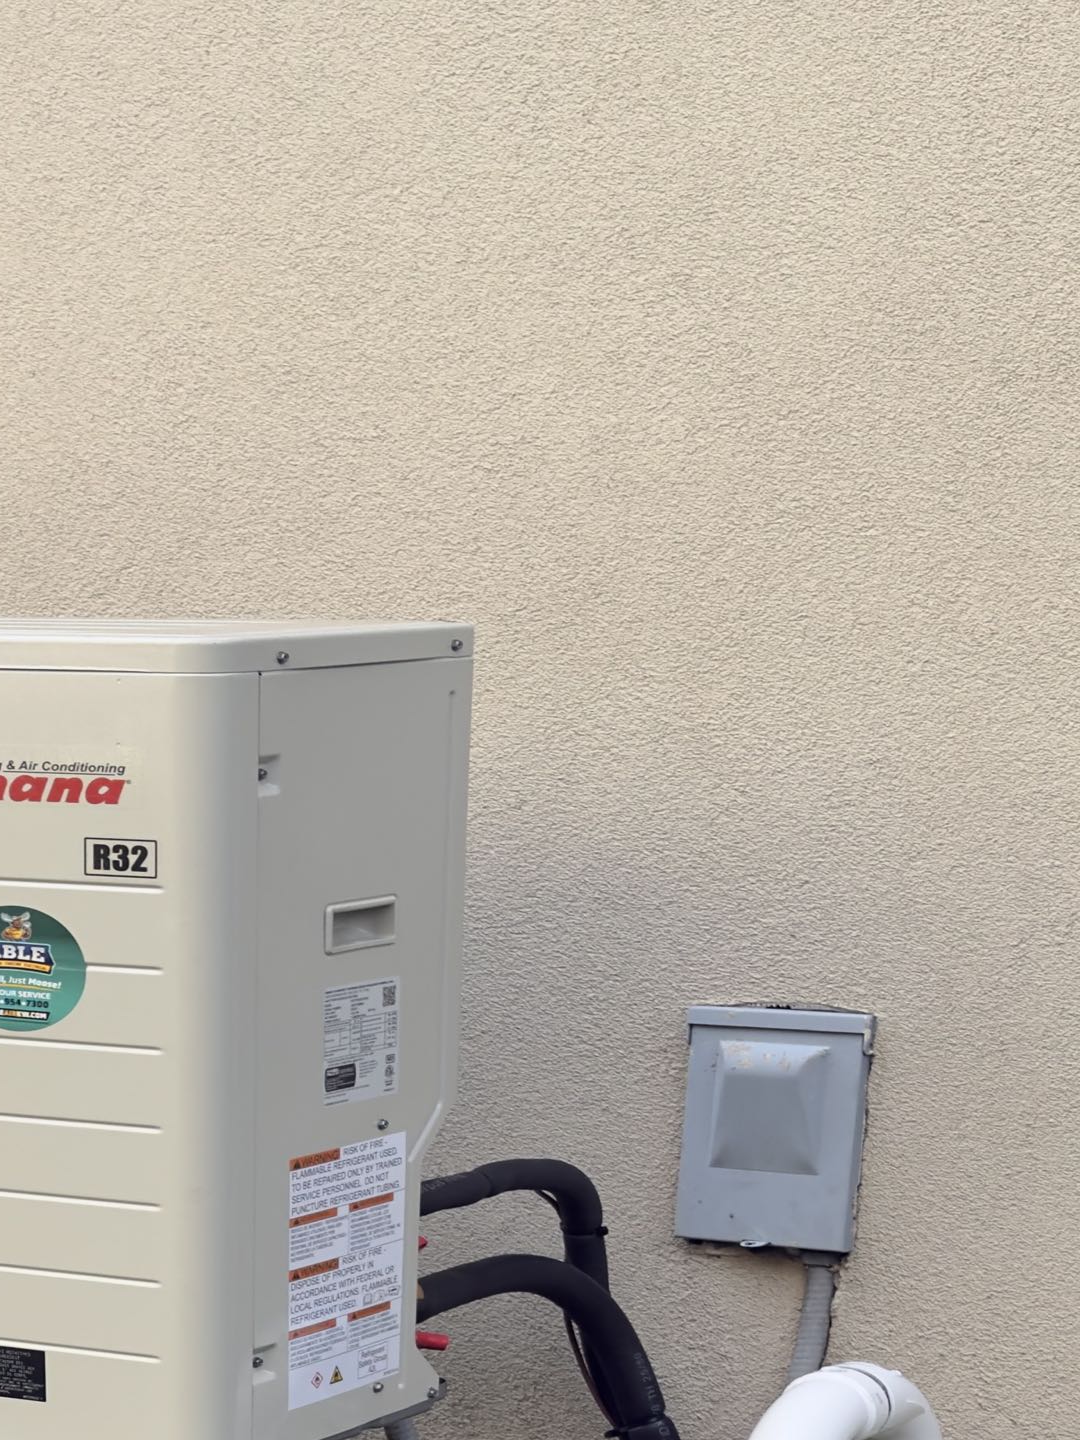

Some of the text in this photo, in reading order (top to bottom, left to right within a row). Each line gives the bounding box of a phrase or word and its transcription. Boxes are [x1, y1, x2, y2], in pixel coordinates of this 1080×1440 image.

[7, 760, 15, 771] &
[18, 760, 38, 771] Air
[42, 761, 126, 776] Conditioning
[93, 844, 148, 872] R32
[8, 976, 27, 985] Just
[17, 991, 51, 1000] SERVICE
[343, 1145, 359, 1155] RISK
[360, 1142, 369, 1152] OF
[369, 1139, 383, 1150] FIRE
[291, 1163, 332, 1180] FLAMMABLE
[333, 1152, 379, 1170] REFRIGERANT
[292, 1157, 402, 1192] TO BE REPAIRED ONLY BY TRAINED
[291, 1190, 321, 1204] SERVICE
[364, 1175, 374, 1185] DO
[375, 1171, 389, 1182] NOT
[291, 1200, 329, 1216] PUNCTURE
[330, 1187, 375, 1206] REFRIGERANT
[342, 1254, 357, 1265] RISK
[358, 1251, 367, 1261] OF
[368, 1247, 382, 1258] FIRE
[290, 1265, 394, 1303] ACCORDANCE WITH FEDERAL OR
[291, 1261, 374, 1291] DISPOSE OF PROPERLY IN
[290, 1300, 313, 1315] LOCAL
[361, 1275, 398, 1293] FLAMMABLE
[290, 1309, 338, 1326] REFRIGERANT
